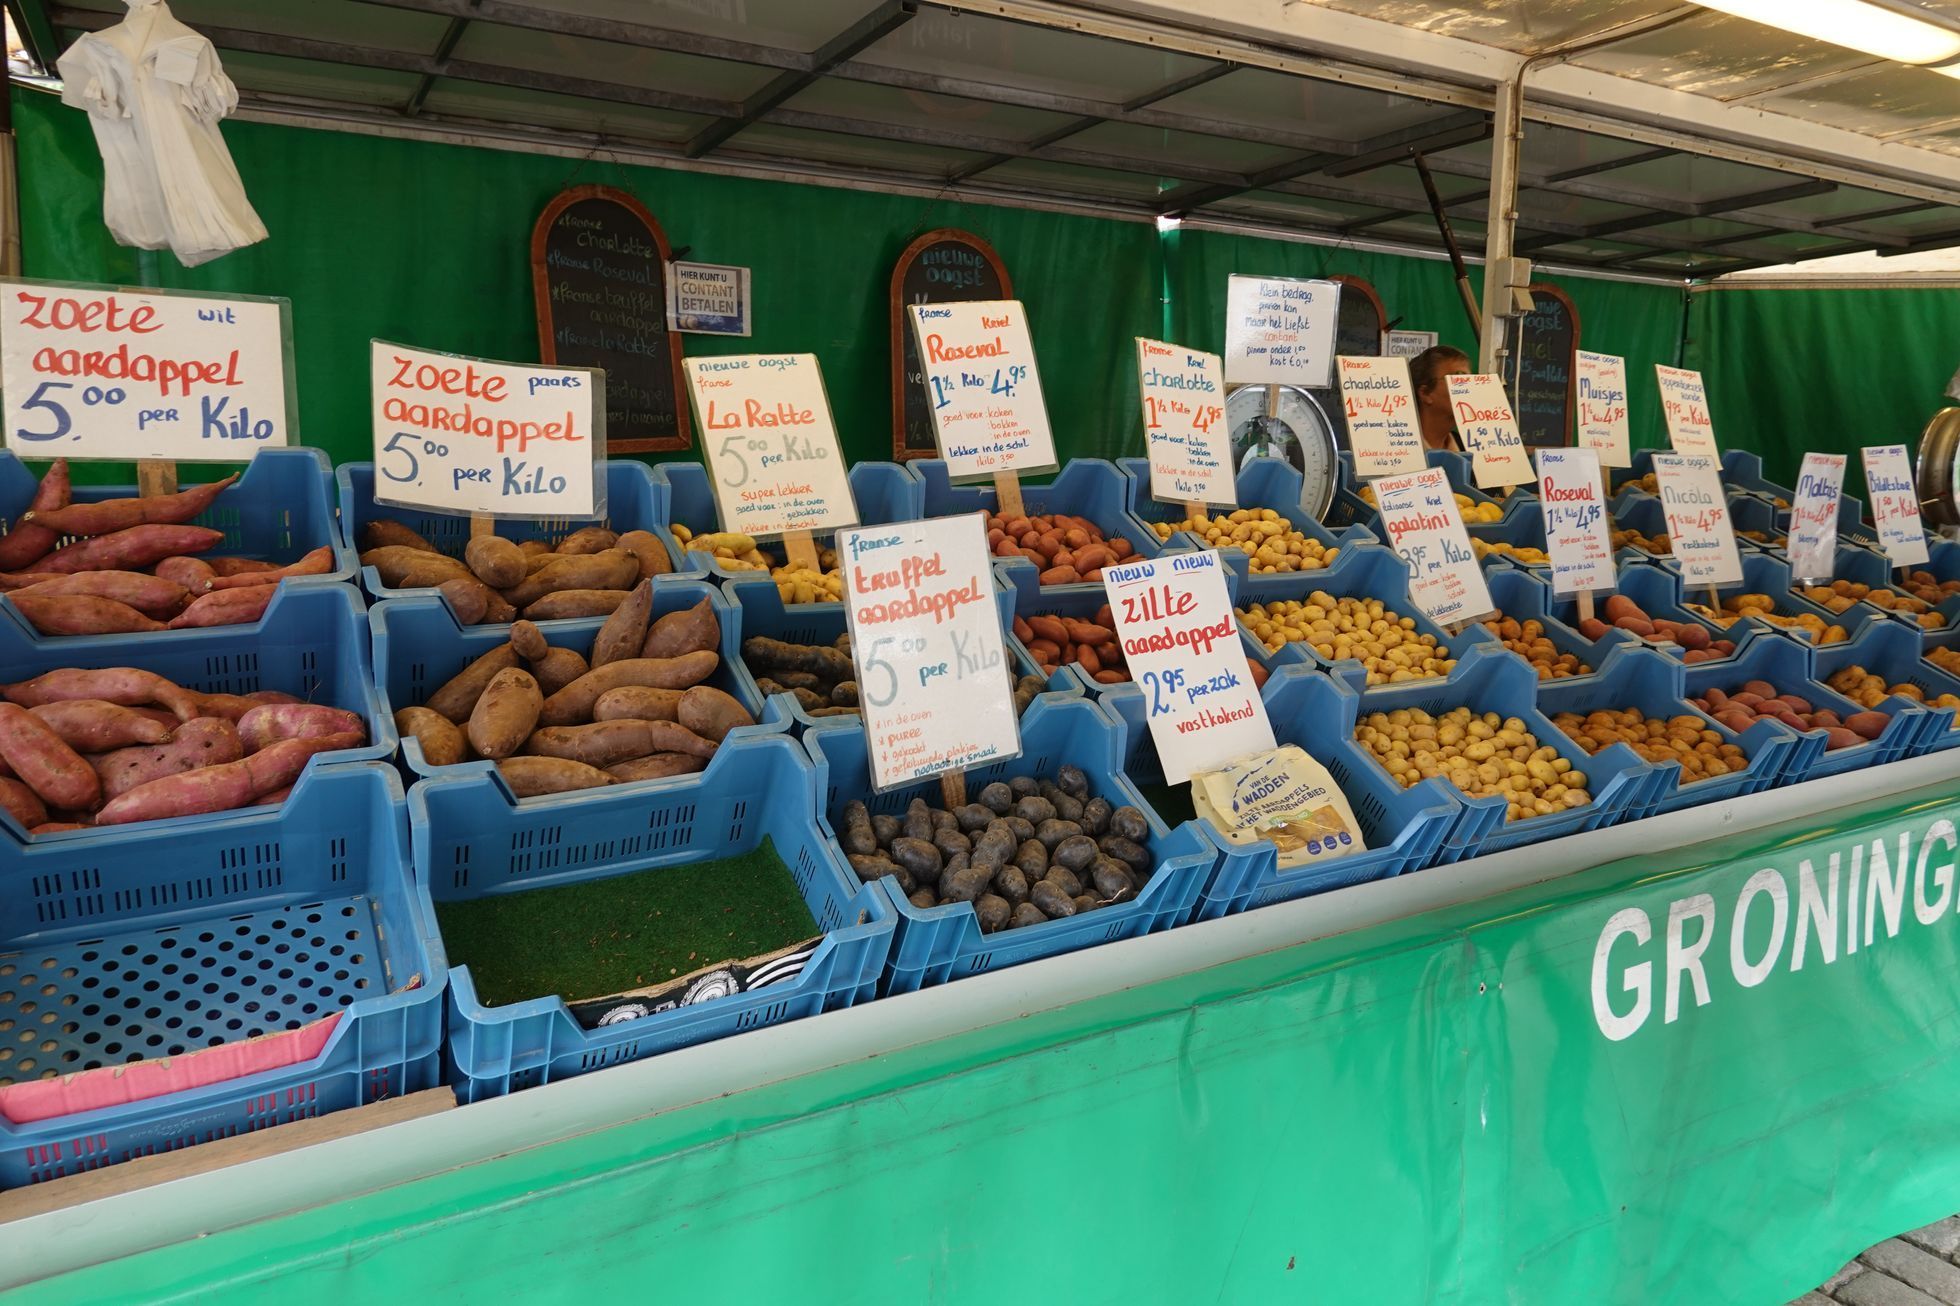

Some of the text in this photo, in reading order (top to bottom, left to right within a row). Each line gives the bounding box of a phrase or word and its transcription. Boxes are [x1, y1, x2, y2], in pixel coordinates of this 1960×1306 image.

[681, 270, 727, 283] HIER KUNT U
[927, 268, 984, 290] oogst
[681, 281, 734, 298] CONTANT
[198, 307, 236, 325] wit
[682, 298, 734, 314] BETALEN
[1284, 300, 1297, 313] kan
[1269, 316, 1282, 329] het
[926, 334, 1010, 365] Roseval
[1247, 345, 1291, 357] pinnen onder
[1270, 355, 1286, 366] kost
[33, 344, 244, 397] aardappel
[699, 356, 798, 373] nieuwe oogst
[528, 376, 582, 395] paars
[696, 376, 733, 394] franse
[1580, 378, 1624, 406] Muisjes
[139, 408, 180, 430] per
[384, 398, 584, 453] aardappel
[708, 399, 815, 430] La Ratte
[993, 443, 1004, 452] de
[761, 454, 783, 468] per
[454, 467, 492, 490] per
[1544, 476, 1596, 502] Roseval
[741, 488, 776, 502] super
[736, 503, 756, 515] goed
[783, 500, 791, 508] in
[807, 498, 824, 506] oven
[849, 534, 904, 561] franse
[855, 552, 946, 594] truffel
[1109, 554, 1214, 583] nieuw nieuw
[857, 575, 985, 626] aardappel
[1124, 614, 1237, 656] aardappel
[919, 661, 948, 687] per
[909, 710, 932, 722] oven
[966, 744, 997, 763] smaak
[1242, 772, 1290, 805] WADDEN
[1250, 775, 1270, 790] VAN DE
[1247, 787, 1327, 825] HET WADDENGEBIED
[1261, 784, 1310, 812] AARDAPPELS
[1591, 819, 1960, 1041] GRONING
